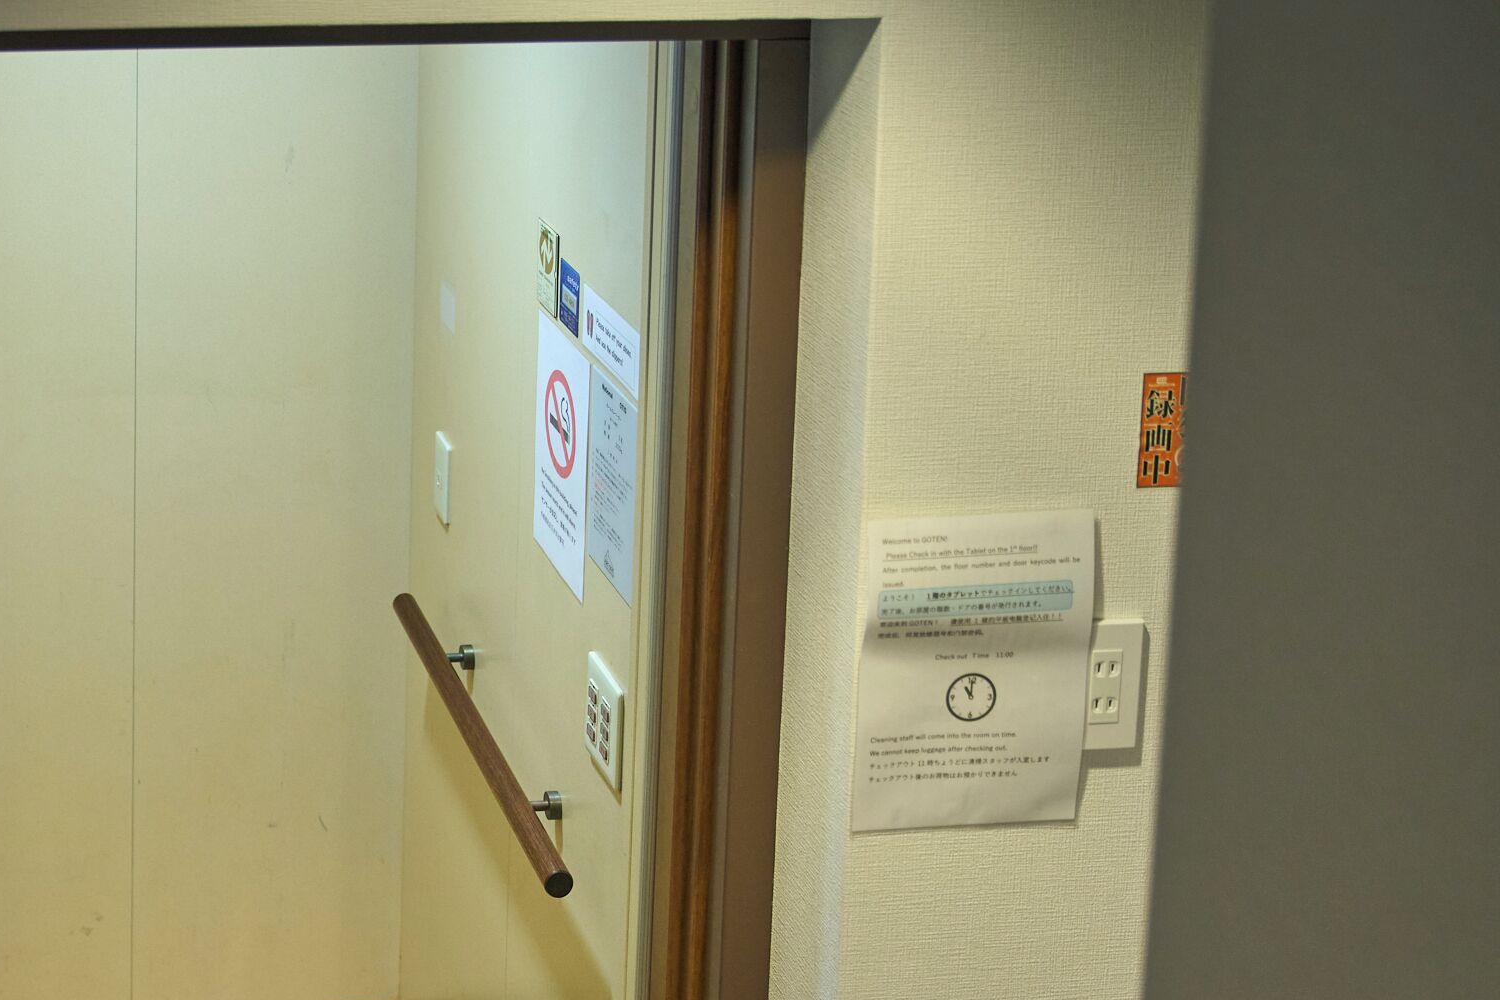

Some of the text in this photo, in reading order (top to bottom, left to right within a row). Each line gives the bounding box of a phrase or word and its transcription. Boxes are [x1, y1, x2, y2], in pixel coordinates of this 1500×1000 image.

[1143, 389, 1175, 485] 録画中
[987, 693, 992, 701] 3
[967, 711, 973, 719] 6
